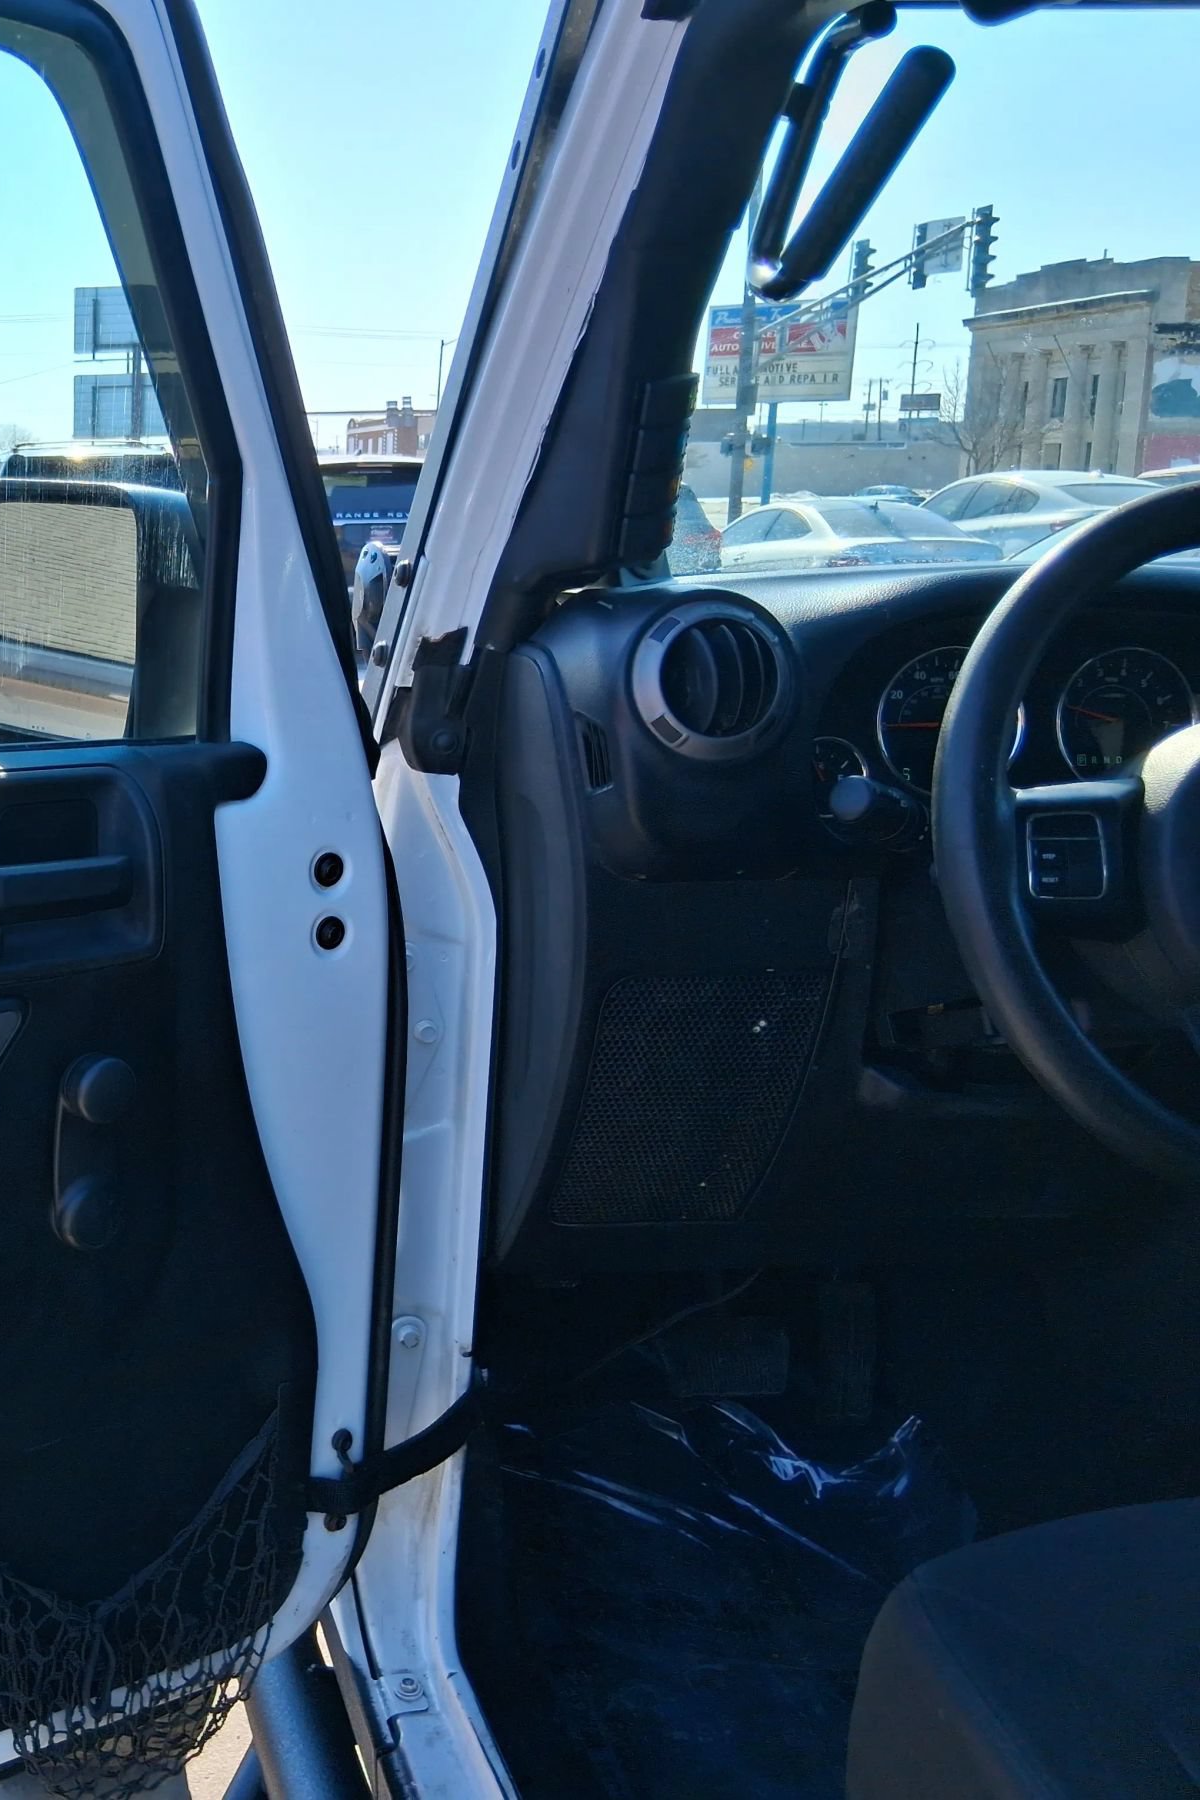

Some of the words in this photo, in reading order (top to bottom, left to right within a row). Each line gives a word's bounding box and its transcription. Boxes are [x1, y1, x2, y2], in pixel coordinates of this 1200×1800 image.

[719, 375, 761, 387] SERE
[764, 375, 785, 385] AD
[890, 690, 903, 700] 20
